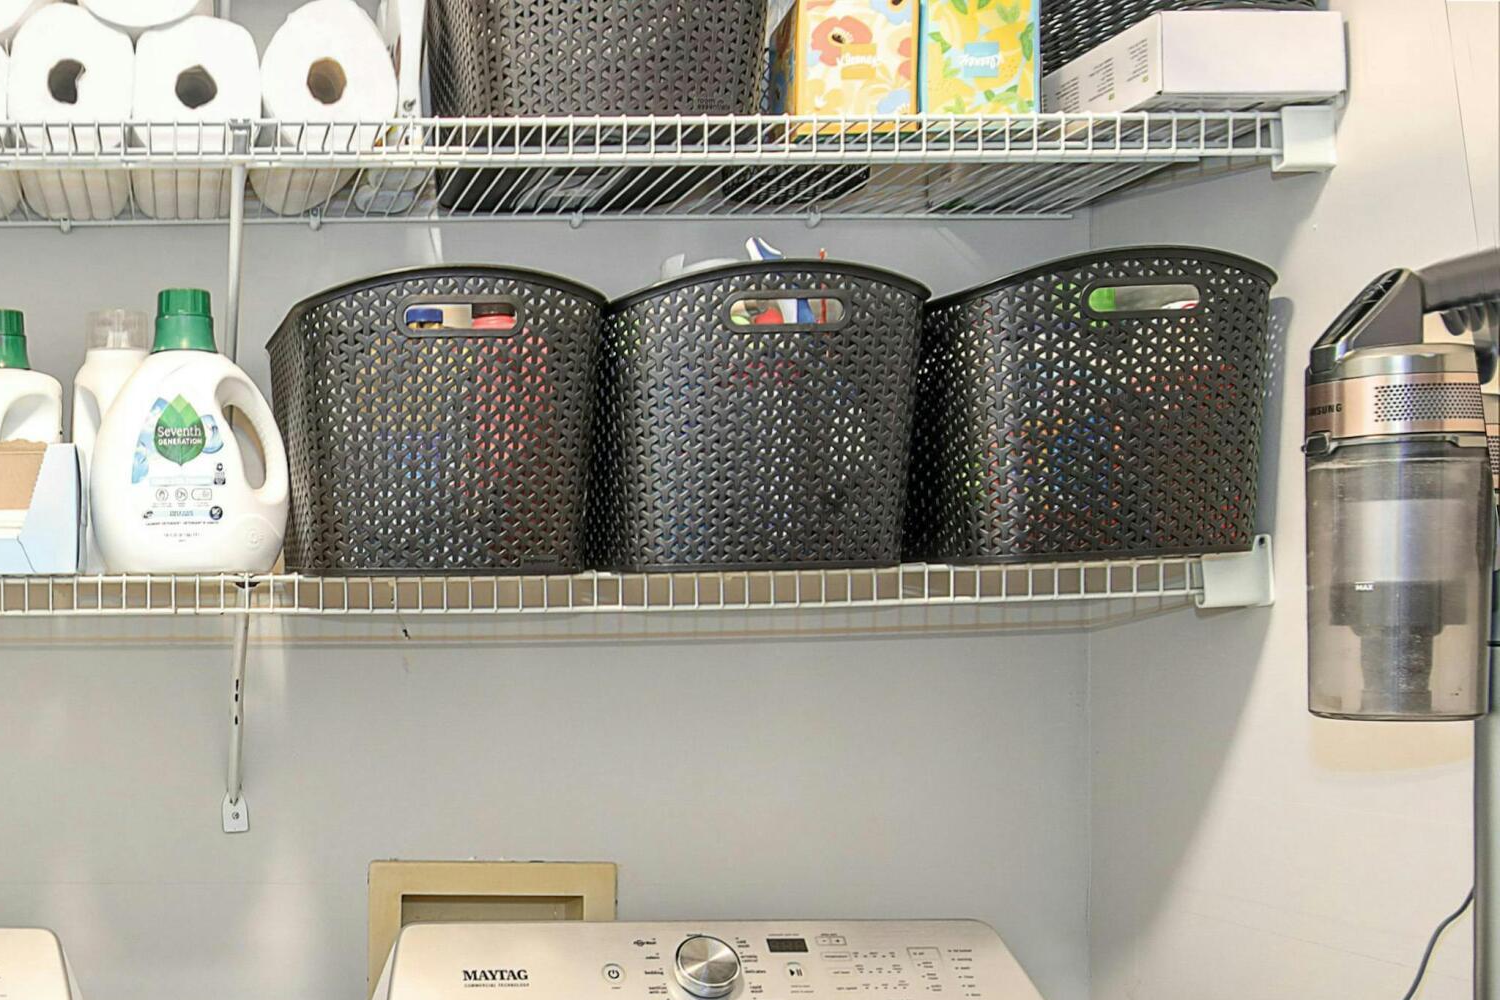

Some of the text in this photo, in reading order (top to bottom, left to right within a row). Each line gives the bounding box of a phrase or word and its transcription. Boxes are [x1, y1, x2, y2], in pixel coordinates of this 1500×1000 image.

[157, 426, 202, 437] Seventh
[158, 438, 203, 446] GENERATION
[462, 969, 529, 981] MAYTAG
